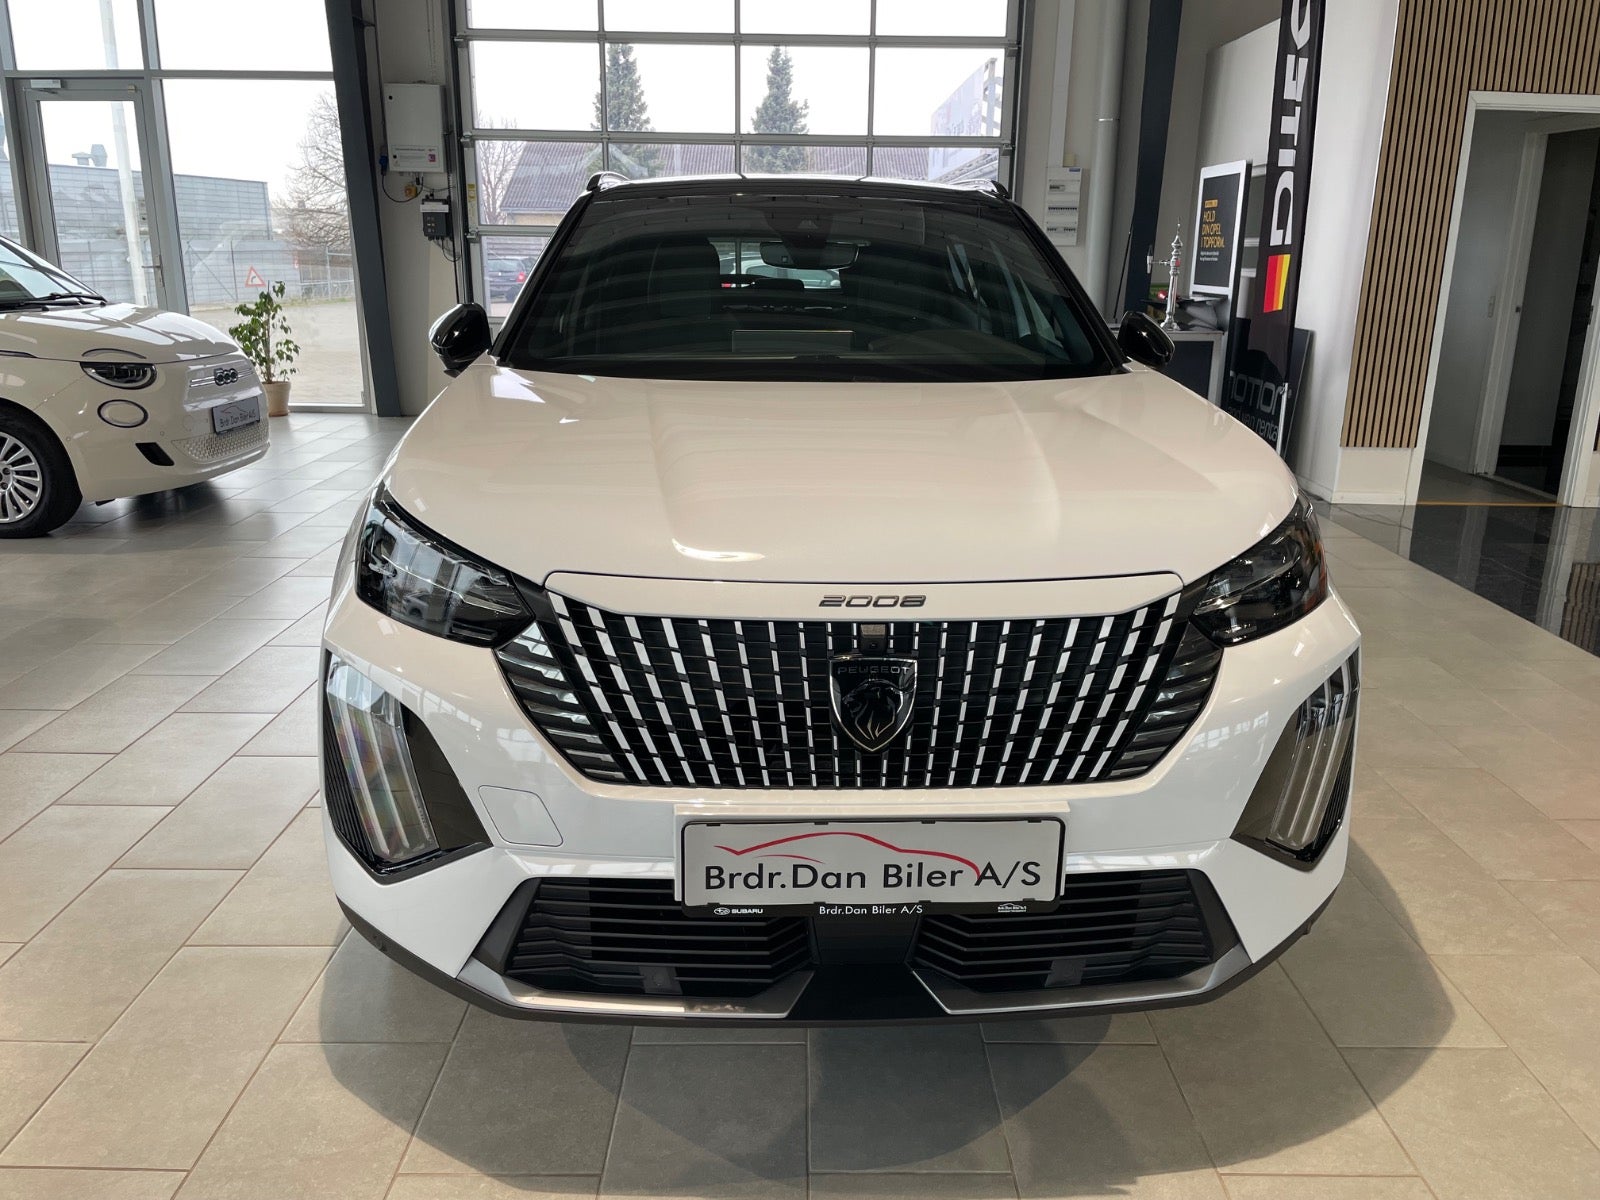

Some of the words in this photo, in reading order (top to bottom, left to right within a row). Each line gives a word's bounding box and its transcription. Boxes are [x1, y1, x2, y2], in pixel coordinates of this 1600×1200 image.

[1255, 417, 1279, 442] renta
[819, 595, 926, 607] 2008
[837, 666, 911, 675] PEUGEOT
[883, 861, 964, 888] Biler
[974, 860, 1041, 889] A/S
[872, 905, 897, 915] Biler
[900, 904, 923, 914] A/S
